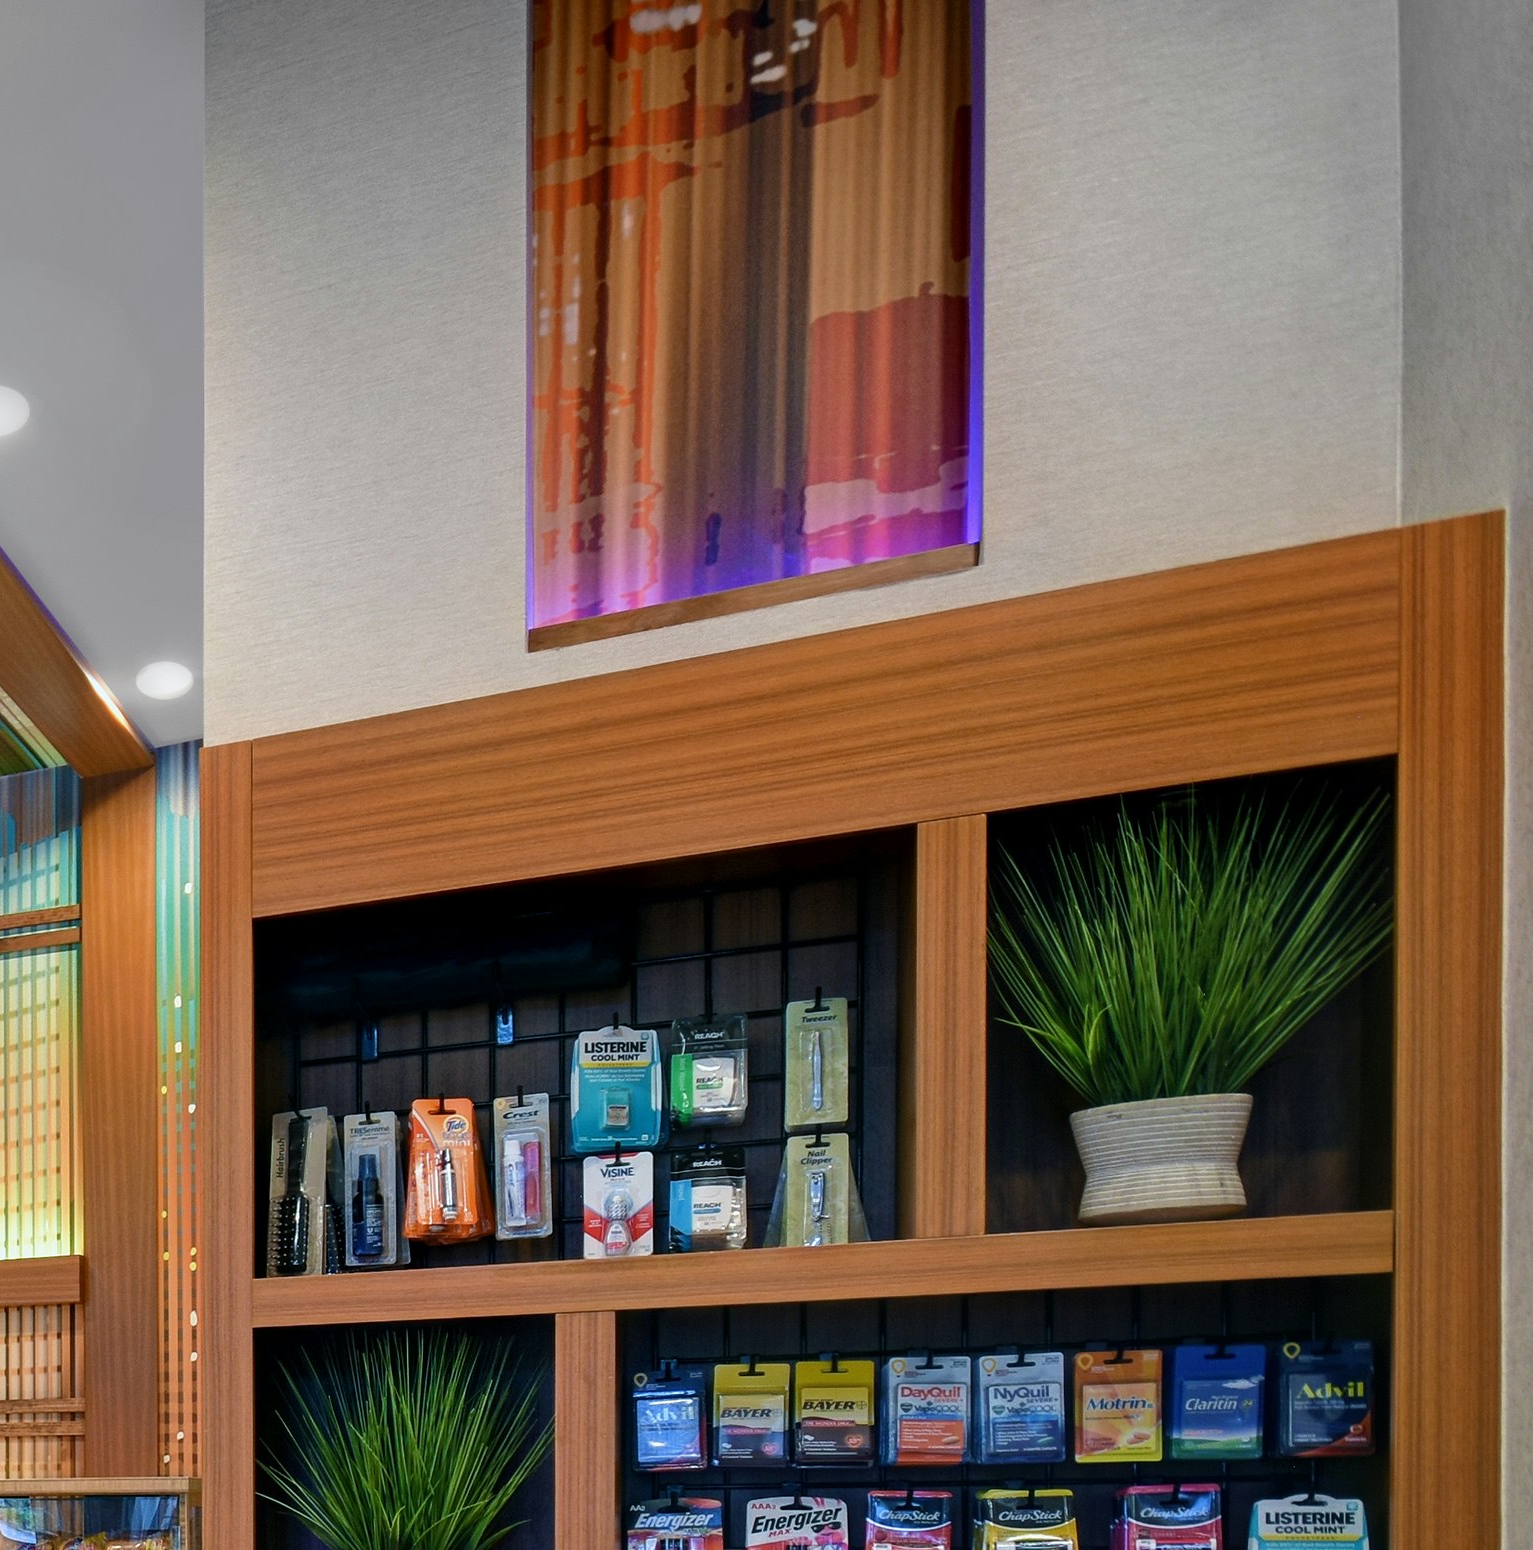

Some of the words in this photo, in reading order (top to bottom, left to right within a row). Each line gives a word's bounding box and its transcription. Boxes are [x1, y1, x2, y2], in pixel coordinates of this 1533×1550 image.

[801, 1014, 837, 1023] Tweezer
[584, 1041, 647, 1054] LISTERINE
[502, 1108, 539, 1120] Crest
[446, 1119, 467, 1132] Tide
[276, 1137, 285, 1179] Hairbrush
[807, 1150, 826, 1158] Nail
[800, 1157, 833, 1166] Clipper
[901, 1387, 961, 1400] DayQuil
[994, 1385, 1050, 1402] NyQuil
[1296, 1381, 1365, 1399] Advil
[802, 1401, 856, 1411] BAYER
[1086, 1396, 1147, 1411] Motrin
[1185, 1397, 1238, 1411] Claritin
[721, 1408, 772, 1418] BAYER
[878, 1510, 942, 1522] ChapStick
[998, 1510, 1063, 1522] ChapStick
[1140, 1506, 1210, 1521] ChapStick
[1265, 1512, 1356, 1526] LISTERINE
[635, 1512, 714, 1532] Energizer
[751, 1507, 843, 1536] Energizer
[768, 1529, 791, 1538] MAX
[1275, 1526, 1311, 1534] COOL
[1313, 1525, 1345, 1534] MINT
